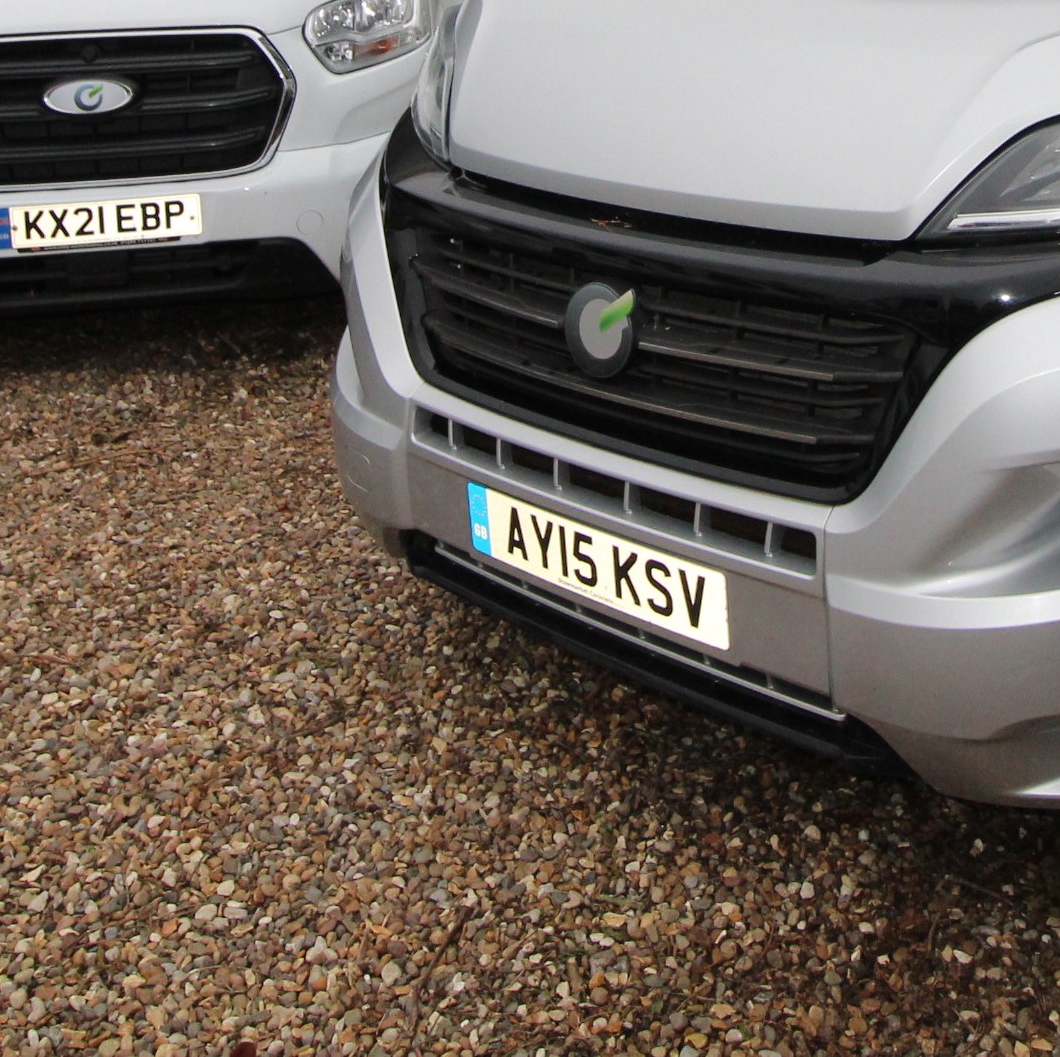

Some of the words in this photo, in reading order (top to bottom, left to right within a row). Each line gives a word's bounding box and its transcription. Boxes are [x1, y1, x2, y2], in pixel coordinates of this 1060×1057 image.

[23, 206, 105, 240] KX21
[116, 200, 185, 234] EBP
[473, 522, 488, 540] GB
[507, 506, 598, 588] AY15
[612, 544, 706, 629] KSV
